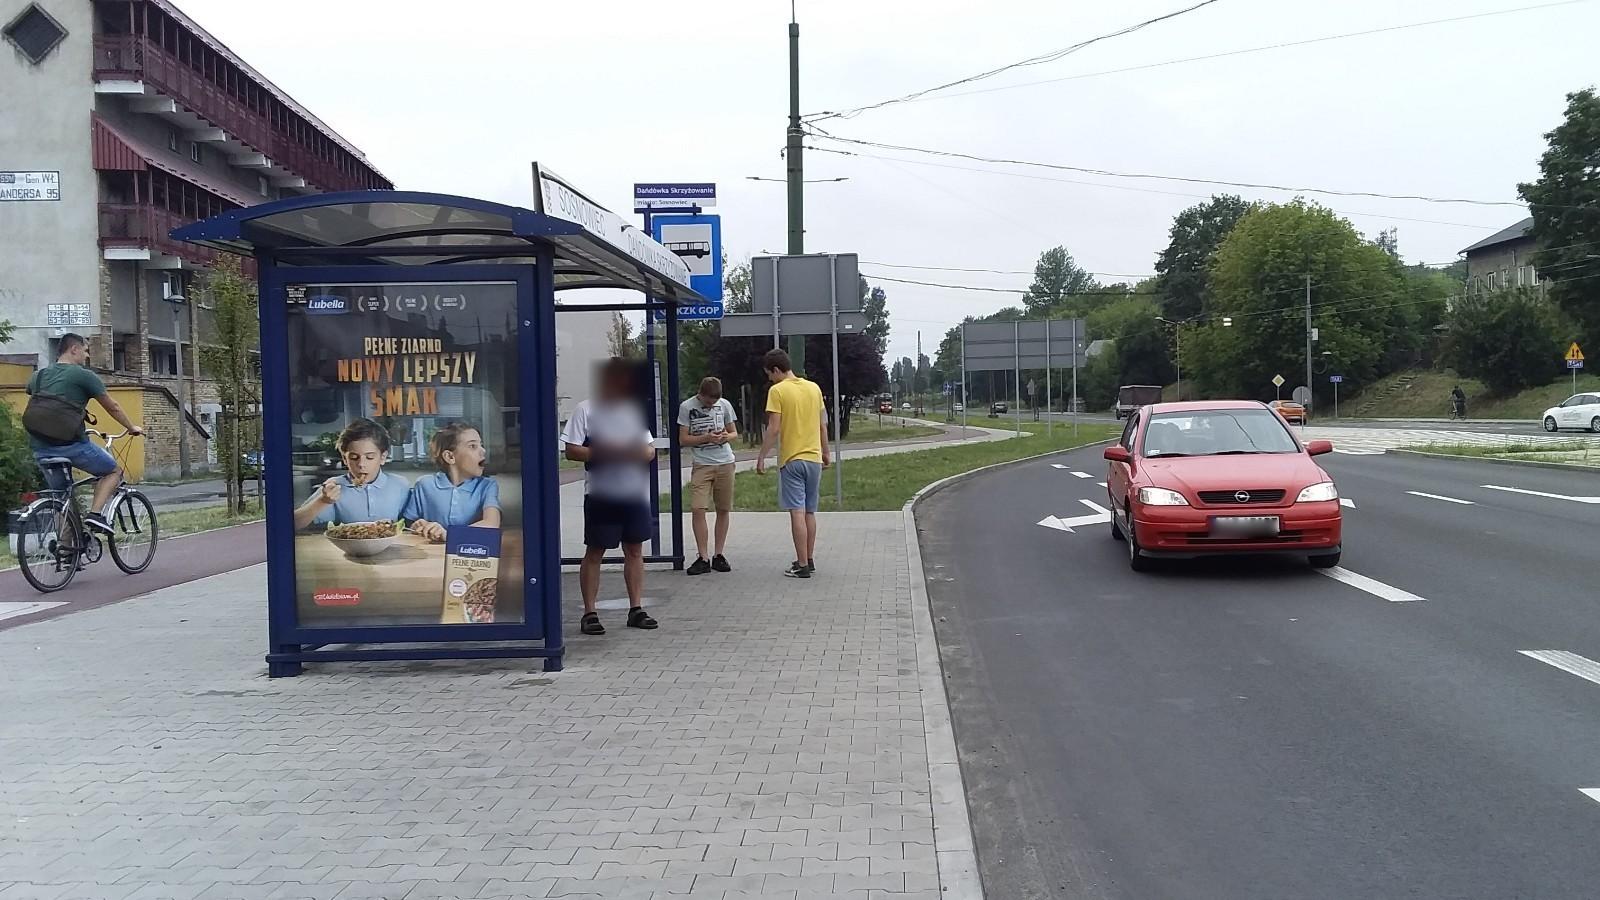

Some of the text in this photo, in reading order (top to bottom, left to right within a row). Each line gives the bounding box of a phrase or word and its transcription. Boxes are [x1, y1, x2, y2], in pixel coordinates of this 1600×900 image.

[0, 189, 58, 198] ANDERSA 95
[671, 187, 714, 195] Skrzyżowanie
[558, 186, 606, 236] SOSNOWIEC
[308, 299, 345, 309] Lubella
[676, 306, 720, 315] KZK GOP
[364, 337, 442, 356] PEŁNE ZIARNO
[337, 351, 477, 384] NOWY LEPSZY
[370, 385, 439, 417] SMAK
[460, 546, 487, 555] Lubella
